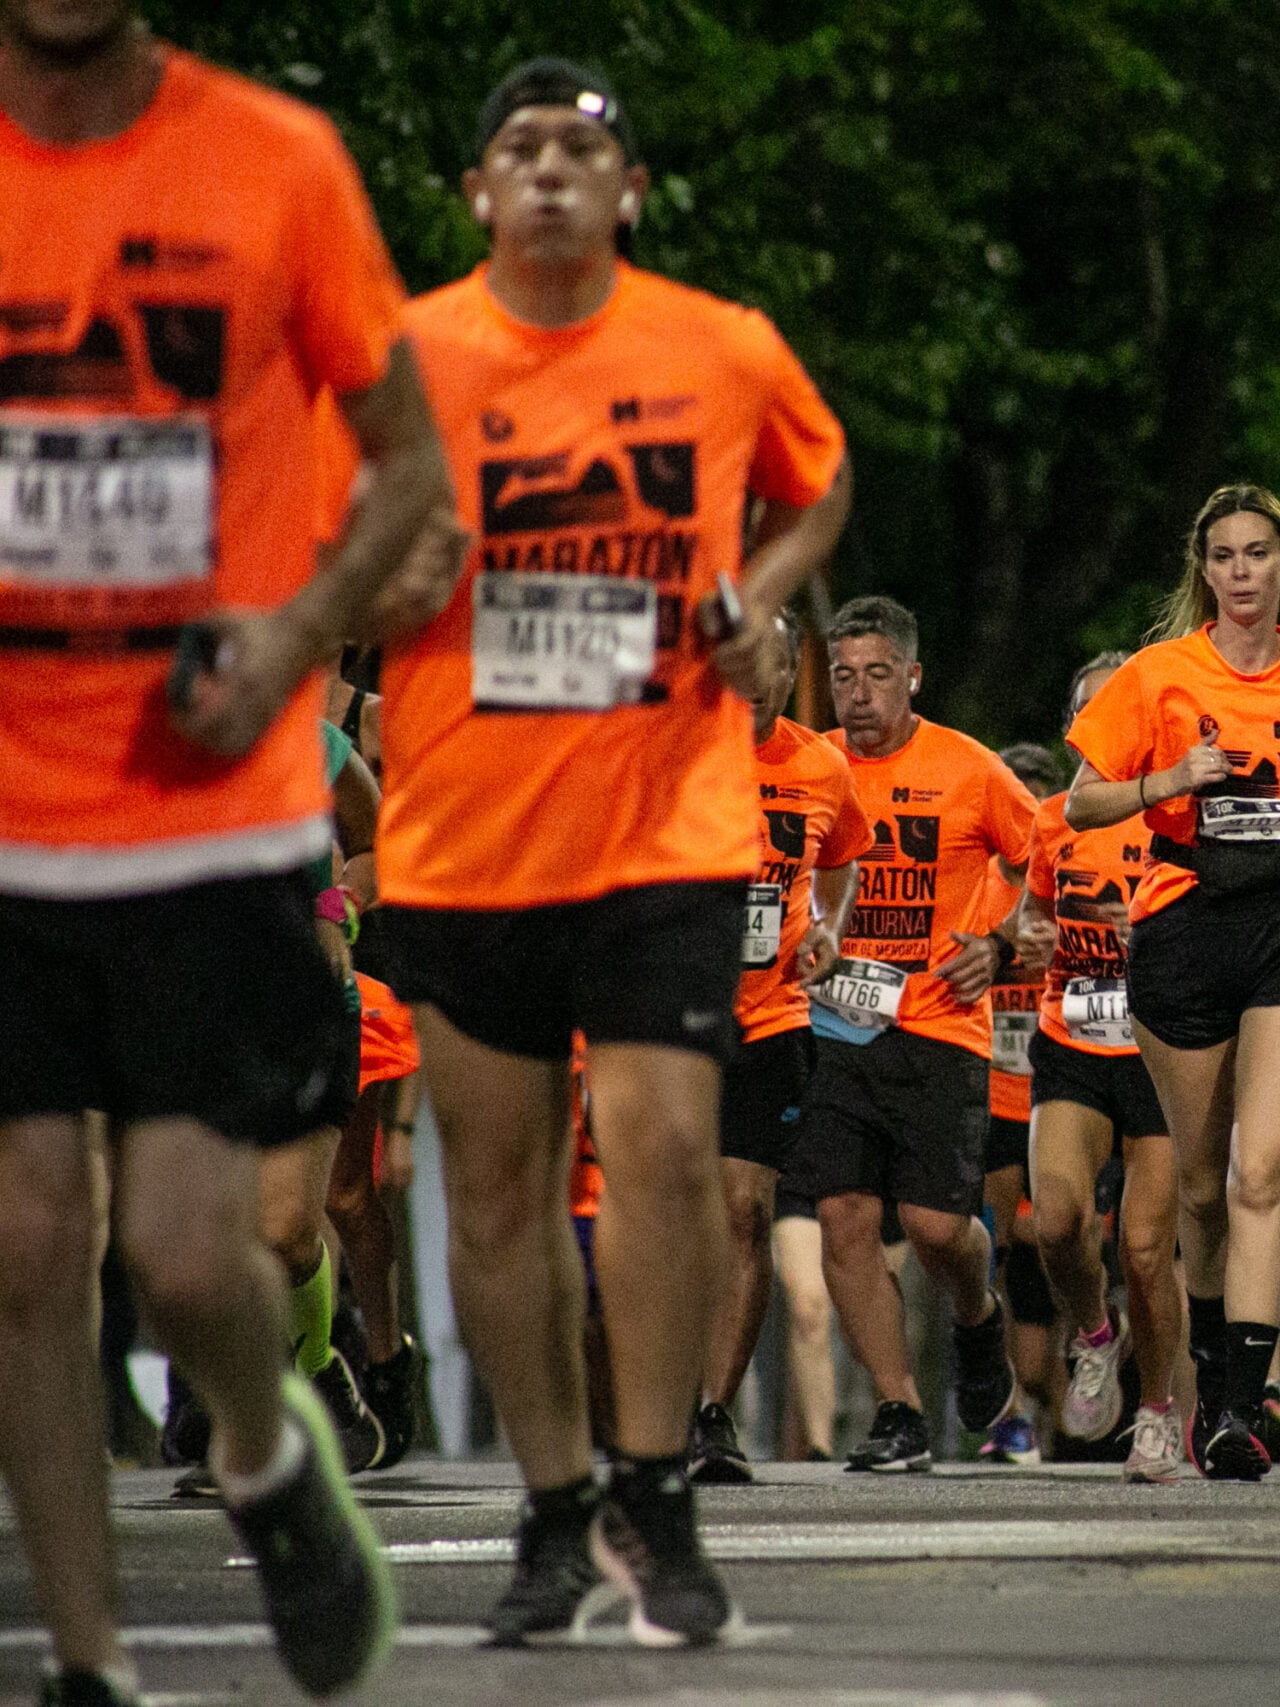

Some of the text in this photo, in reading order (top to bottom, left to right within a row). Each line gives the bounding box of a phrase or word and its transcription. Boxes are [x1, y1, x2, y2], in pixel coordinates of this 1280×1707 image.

[1215, 801, 1237, 815] 10K
[857, 862, 938, 901] RATÓN
[848, 909, 927, 936] CTURNA
[1078, 980, 1096, 994] 10K
